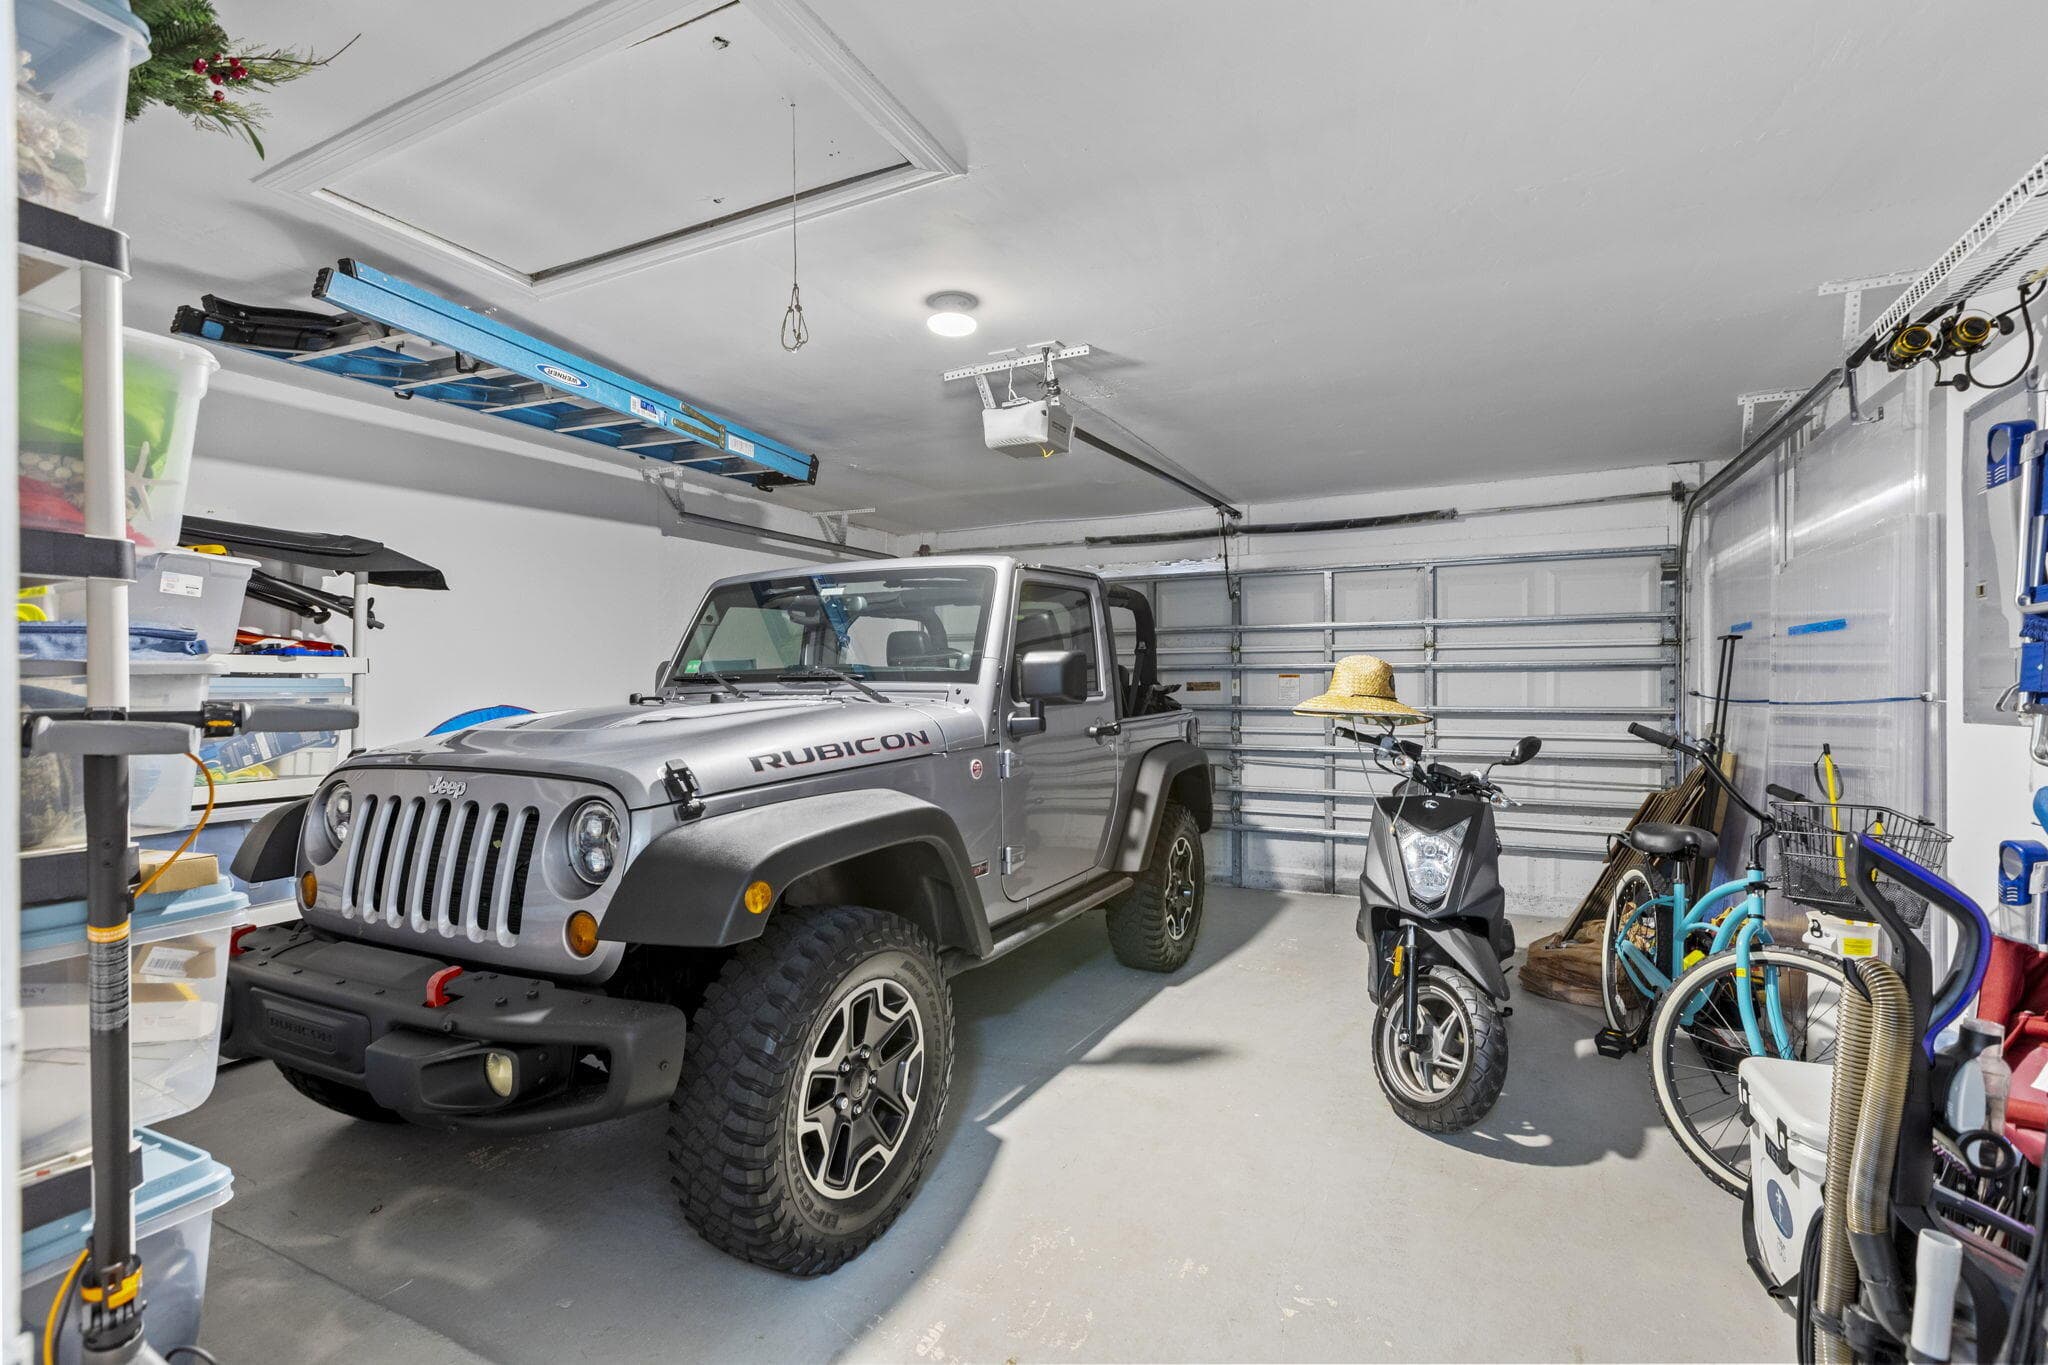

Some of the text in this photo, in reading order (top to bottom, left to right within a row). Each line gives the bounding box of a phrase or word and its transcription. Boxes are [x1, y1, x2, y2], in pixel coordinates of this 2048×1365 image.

[547, 368, 578, 384] WERNER
[749, 730, 930, 773] RUBICON
[429, 776, 467, 799] Jeep
